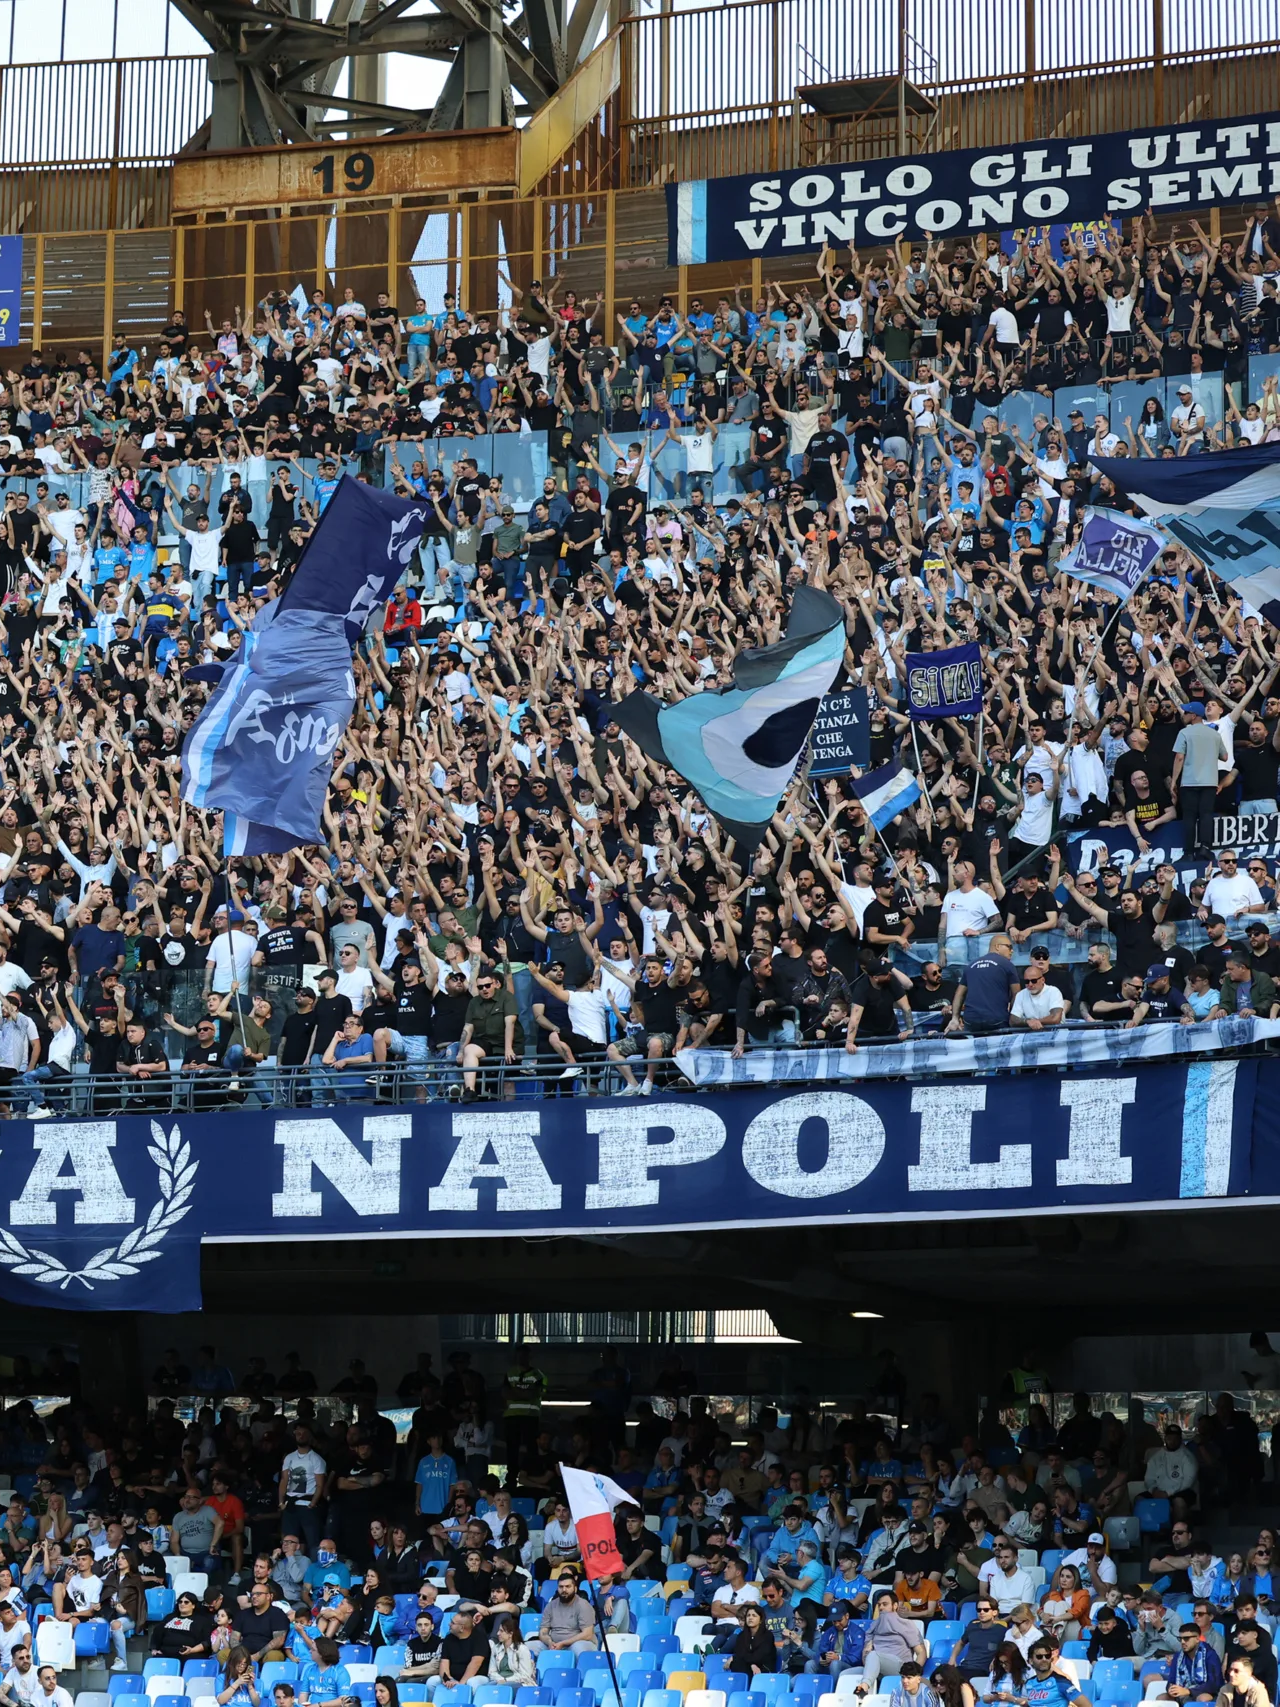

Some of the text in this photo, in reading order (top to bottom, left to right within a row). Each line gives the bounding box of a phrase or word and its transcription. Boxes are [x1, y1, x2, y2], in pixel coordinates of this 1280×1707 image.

[312, 152, 374, 194] 19
[749, 164, 933, 213] SOLO
[970, 144, 1093, 188] GLI
[734, 161, 1280, 250] VINCONO SEM
[812, 716, 859, 730] STANZA
[816, 731, 844, 745] CHE
[812, 745, 853, 760] TENGA
[267, 929, 292, 940] CURVA
[277, 938, 286, 946] A
[270, 944, 294, 953] NAPOLI
[271, 1076, 1137, 1218] NAPOLI
[9, 1121, 136, 1225] A
